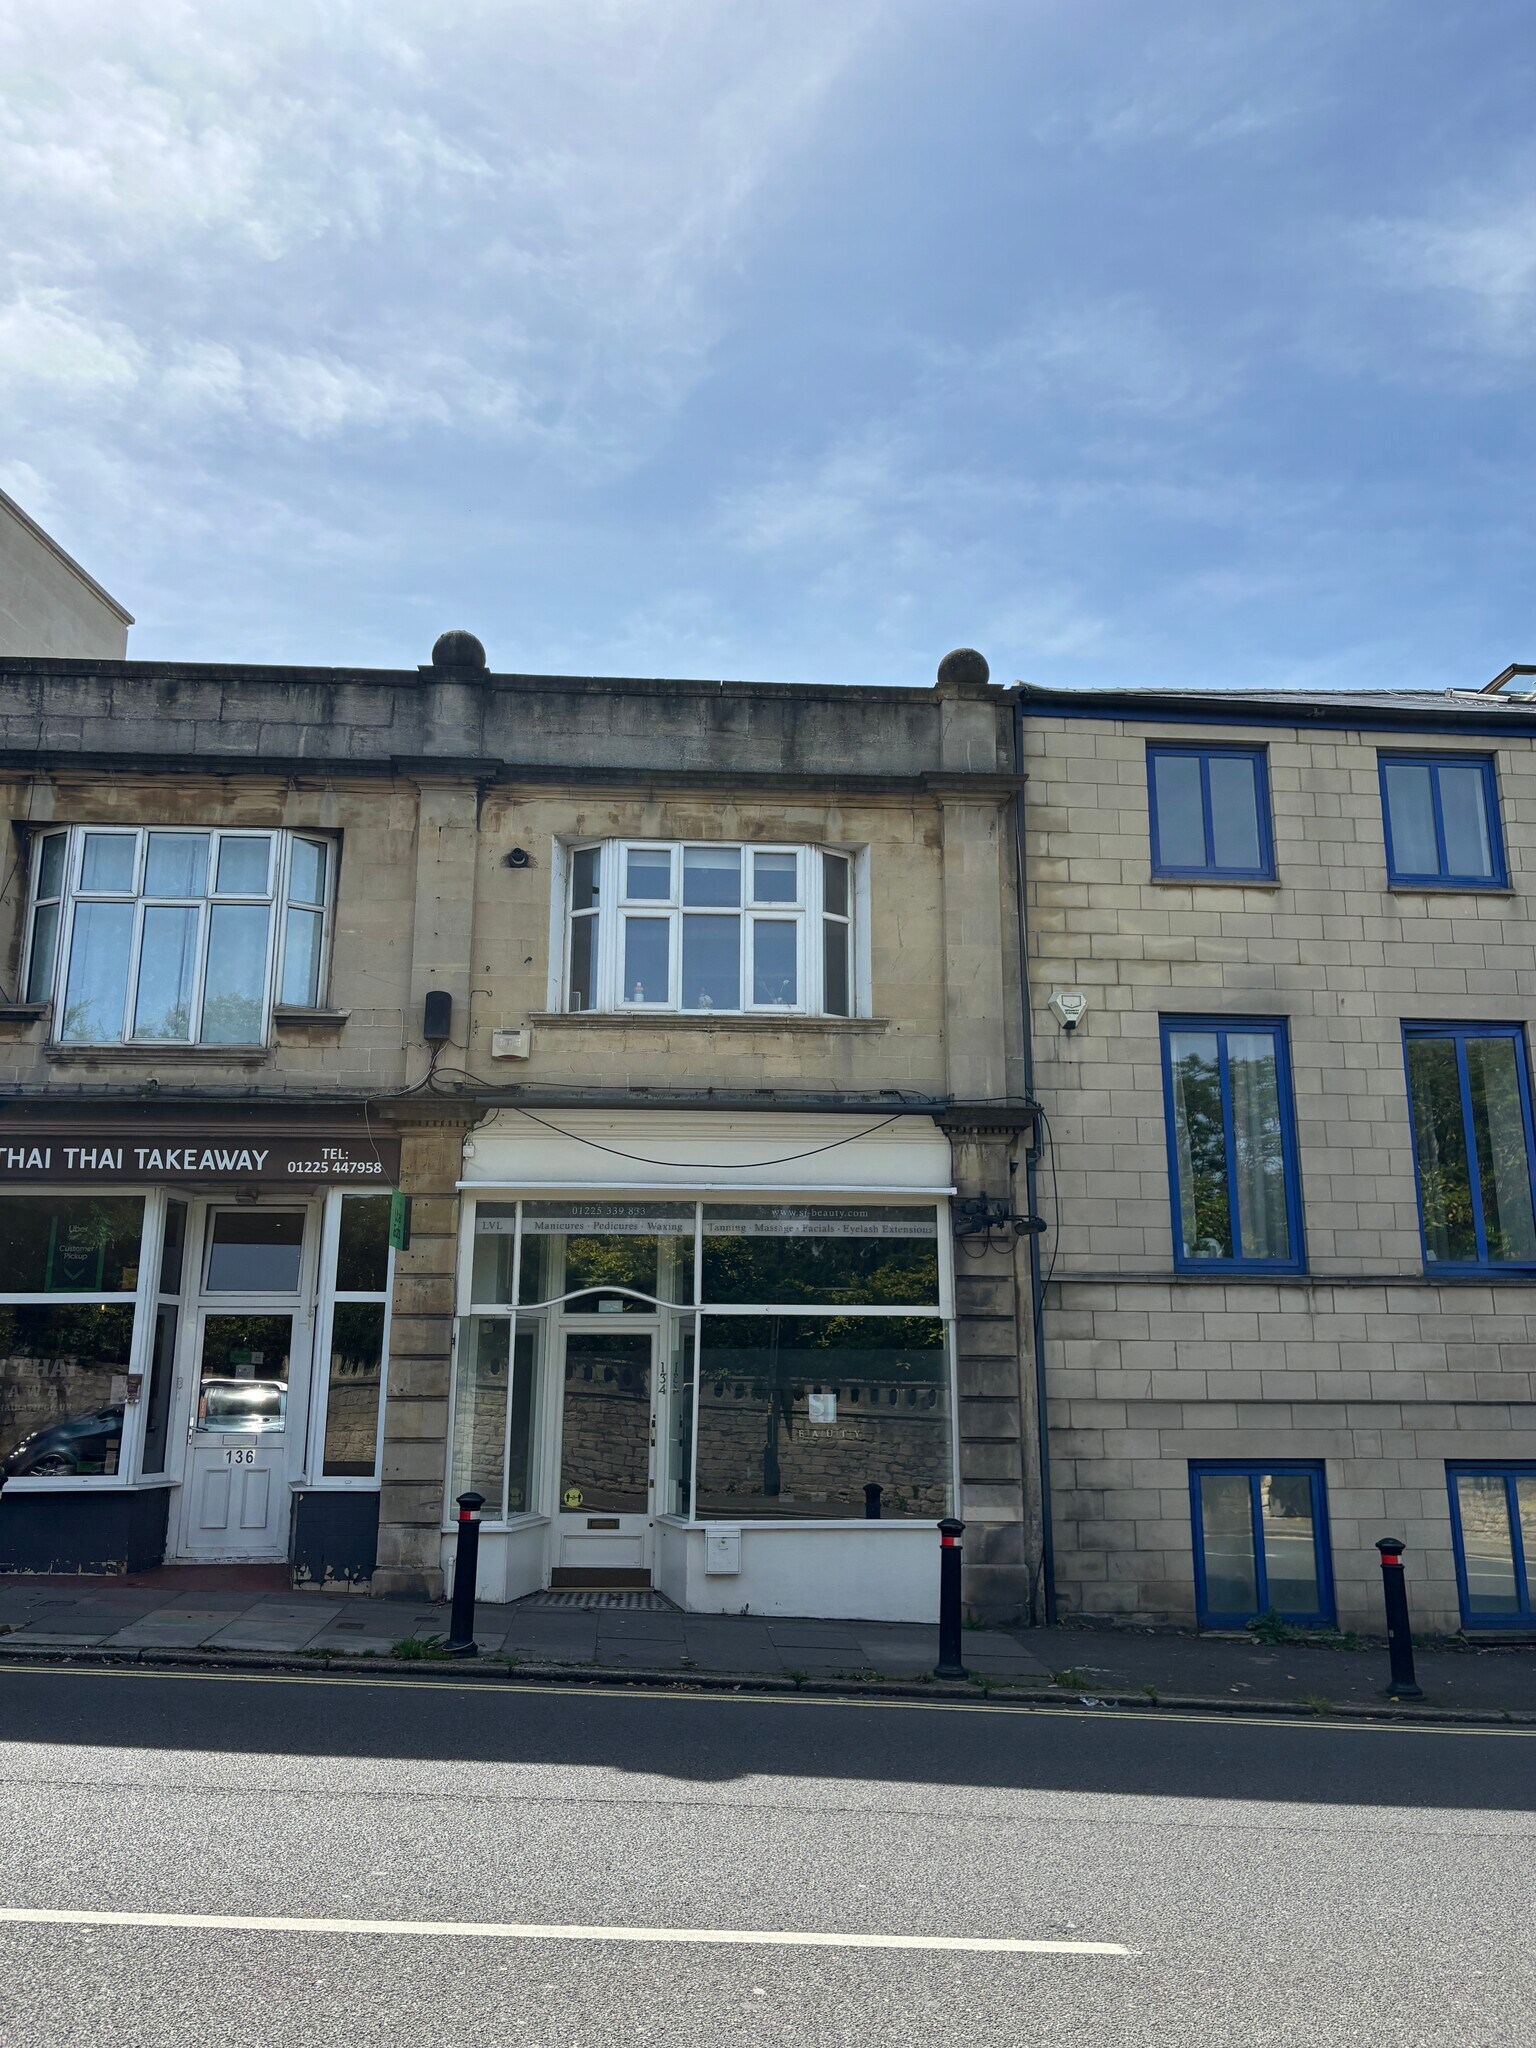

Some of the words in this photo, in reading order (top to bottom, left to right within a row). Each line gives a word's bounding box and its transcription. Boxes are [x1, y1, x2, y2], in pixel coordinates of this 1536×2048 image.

[62, 1148, 123, 1169] THAI
[133, 1148, 269, 1171] TAKEAWAY
[321, 1148, 349, 1160] TEL:
[287, 1161, 329, 1174] 01225
[331, 1161, 382, 1174] 447958
[571, 1206, 602, 1215] 01225
[606, 1206, 625, 1216] 339
[628, 1207, 646, 1216] 833
[482, 1221, 503, 1230] LVL
[534, 1221, 585, 1230] Manicures
[593, 1221, 638, 1231] Pedicures
[647, 1221, 683, 1232] Waxing
[707, 1223, 747, 1233] Tanning
[802, 1223, 835, 1234] Facials
[842, 1224, 879, 1235] Eyelash
[882, 1225, 933, 1234] Extensions
[59, 1244, 95, 1252] Customer
[64, 1252, 88, 1260] Pickup
[226, 1449, 255, 1464] 136
